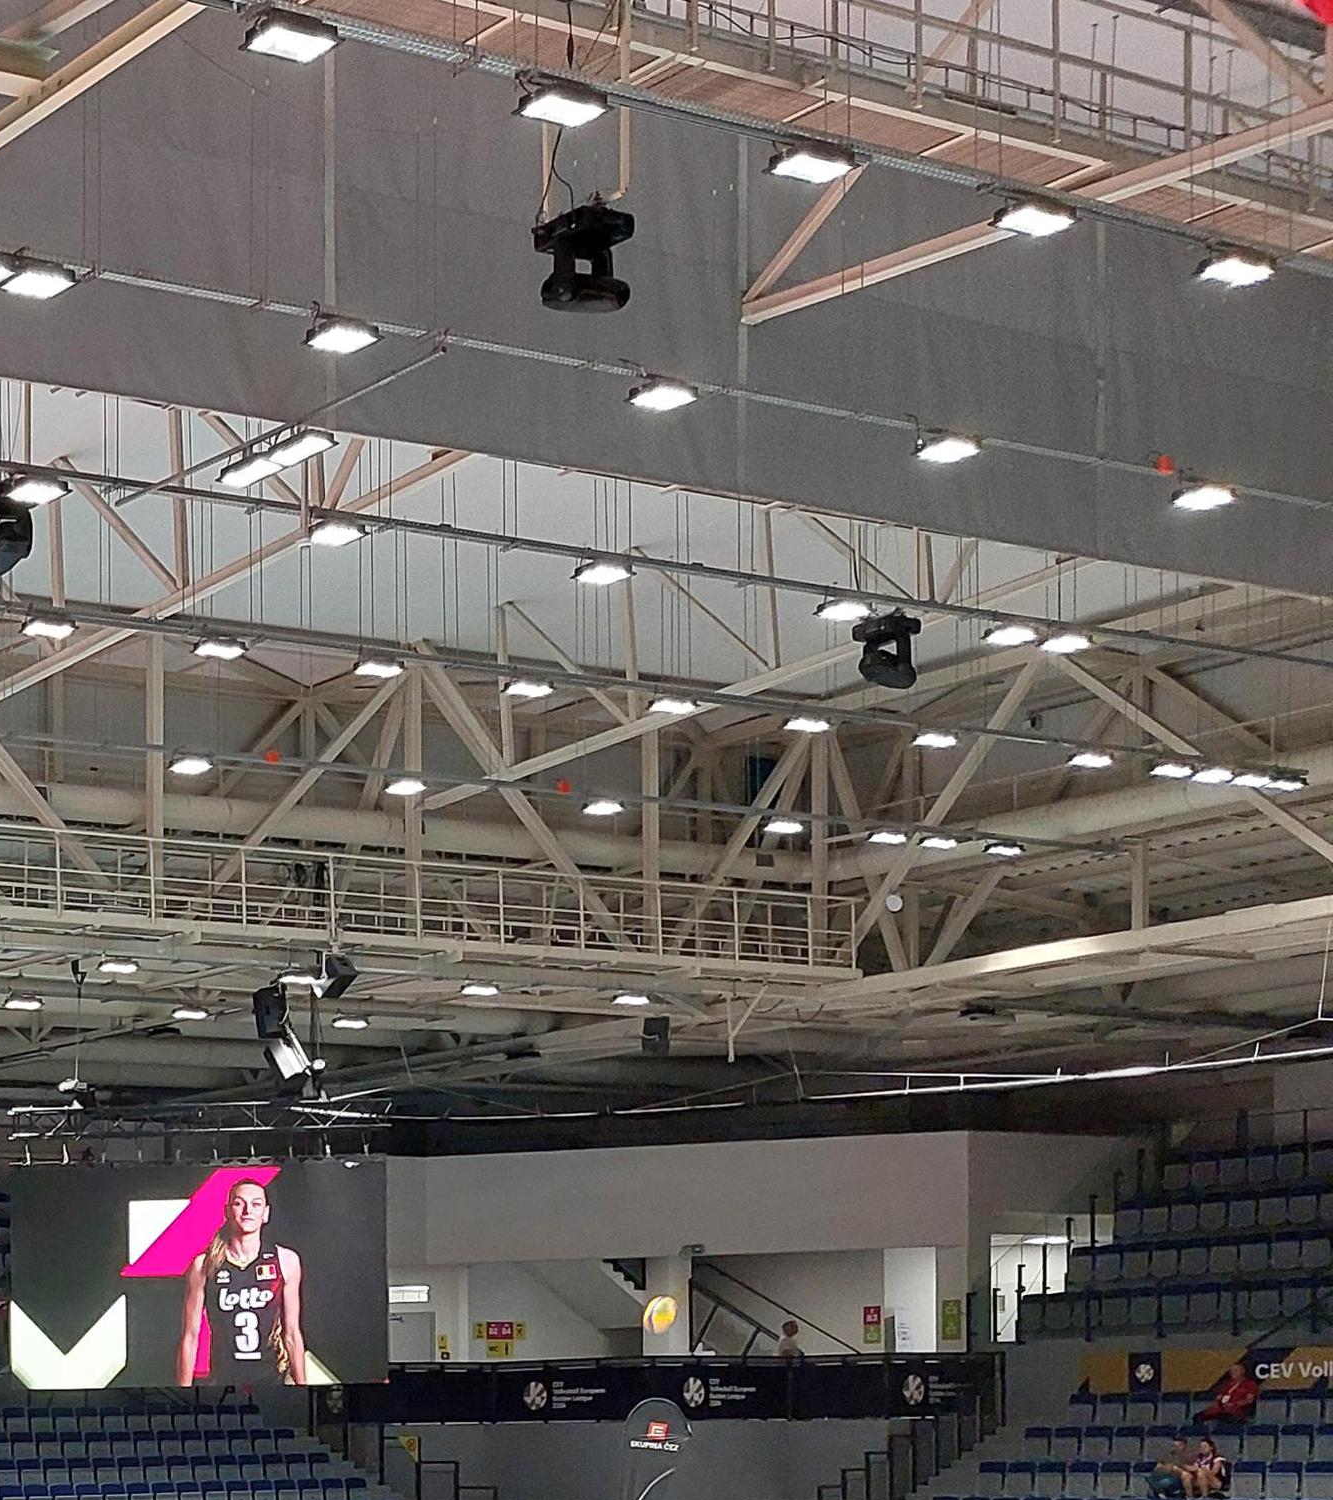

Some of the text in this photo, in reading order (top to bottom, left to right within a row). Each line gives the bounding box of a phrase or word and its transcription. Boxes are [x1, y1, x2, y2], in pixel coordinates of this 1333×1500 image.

[219, 1287, 274, 1311] lotto
[234, 1311, 260, 1352] 3
[1254, 1362, 1294, 1380] CEV
